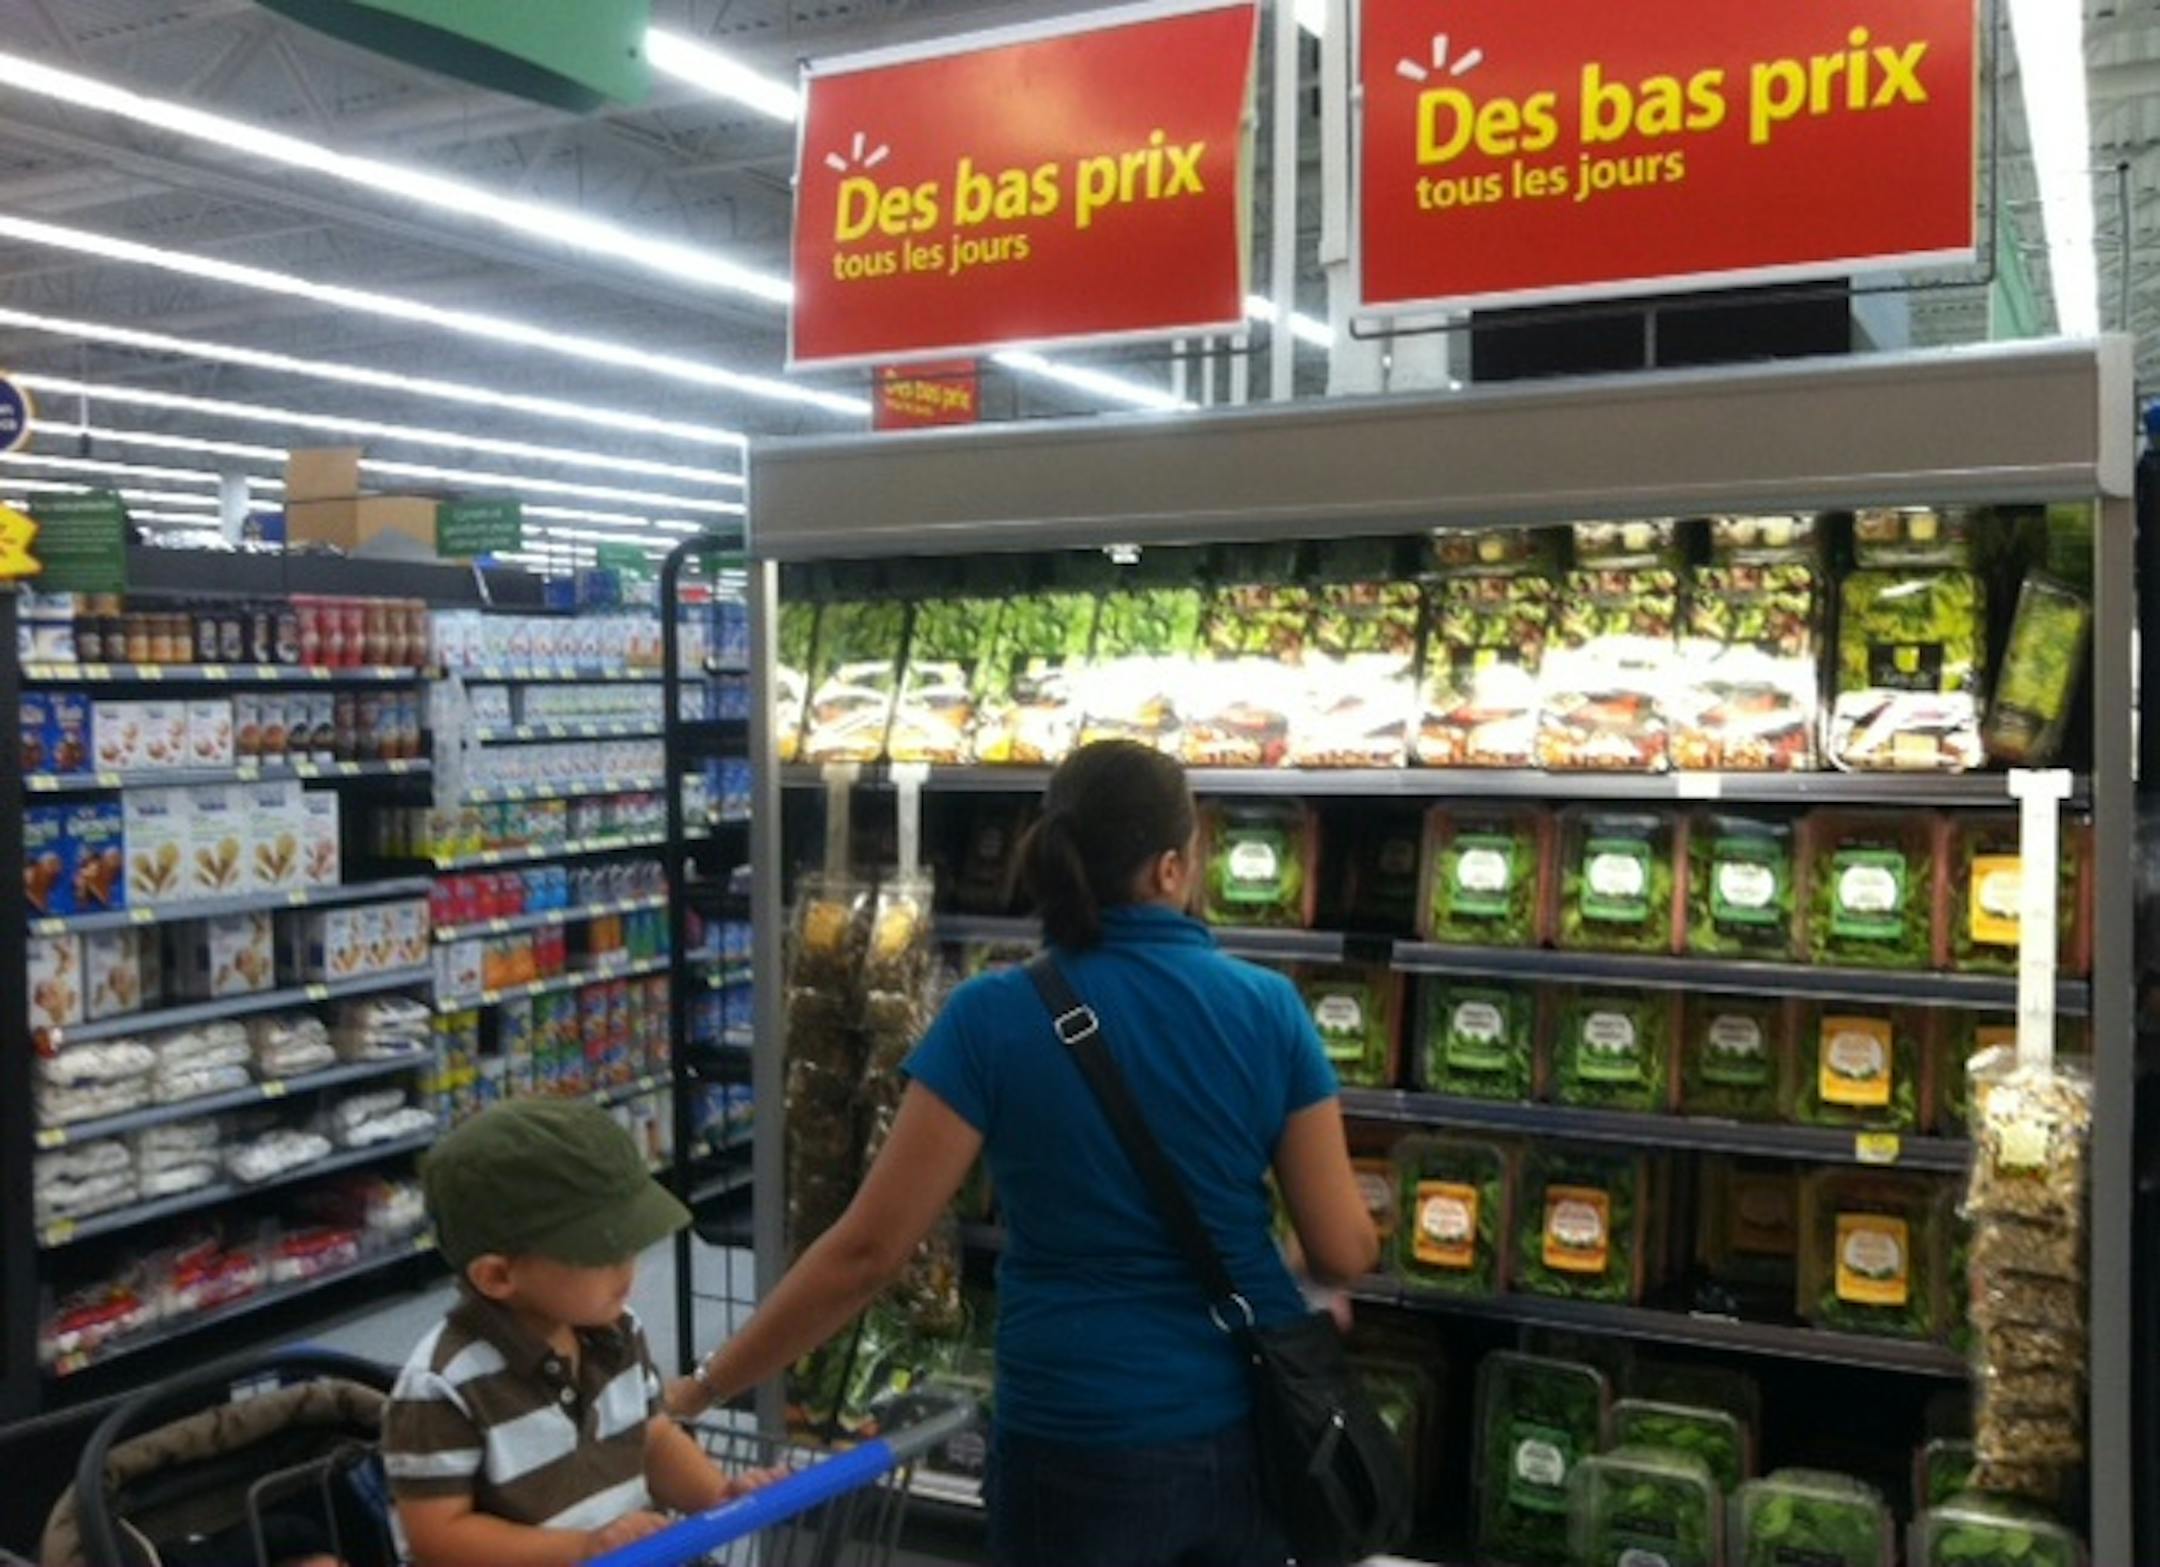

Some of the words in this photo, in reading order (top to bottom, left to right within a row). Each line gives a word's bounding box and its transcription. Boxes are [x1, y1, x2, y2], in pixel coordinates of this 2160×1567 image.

[1417, 87, 1558, 164] Des
[1580, 63, 1726, 144] bas
[1751, 27, 1928, 144] prix
[835, 176, 940, 243] Des
[953, 156, 1061, 226] bas
[1075, 129, 1208, 228] prix
[1416, 176, 1502, 209] tous
[1514, 161, 1568, 199] les
[1575, 151, 1684, 202] jours
[833, 251, 897, 280] tous
[903, 238, 944, 272] les
[949, 233, 1029, 275] jours
